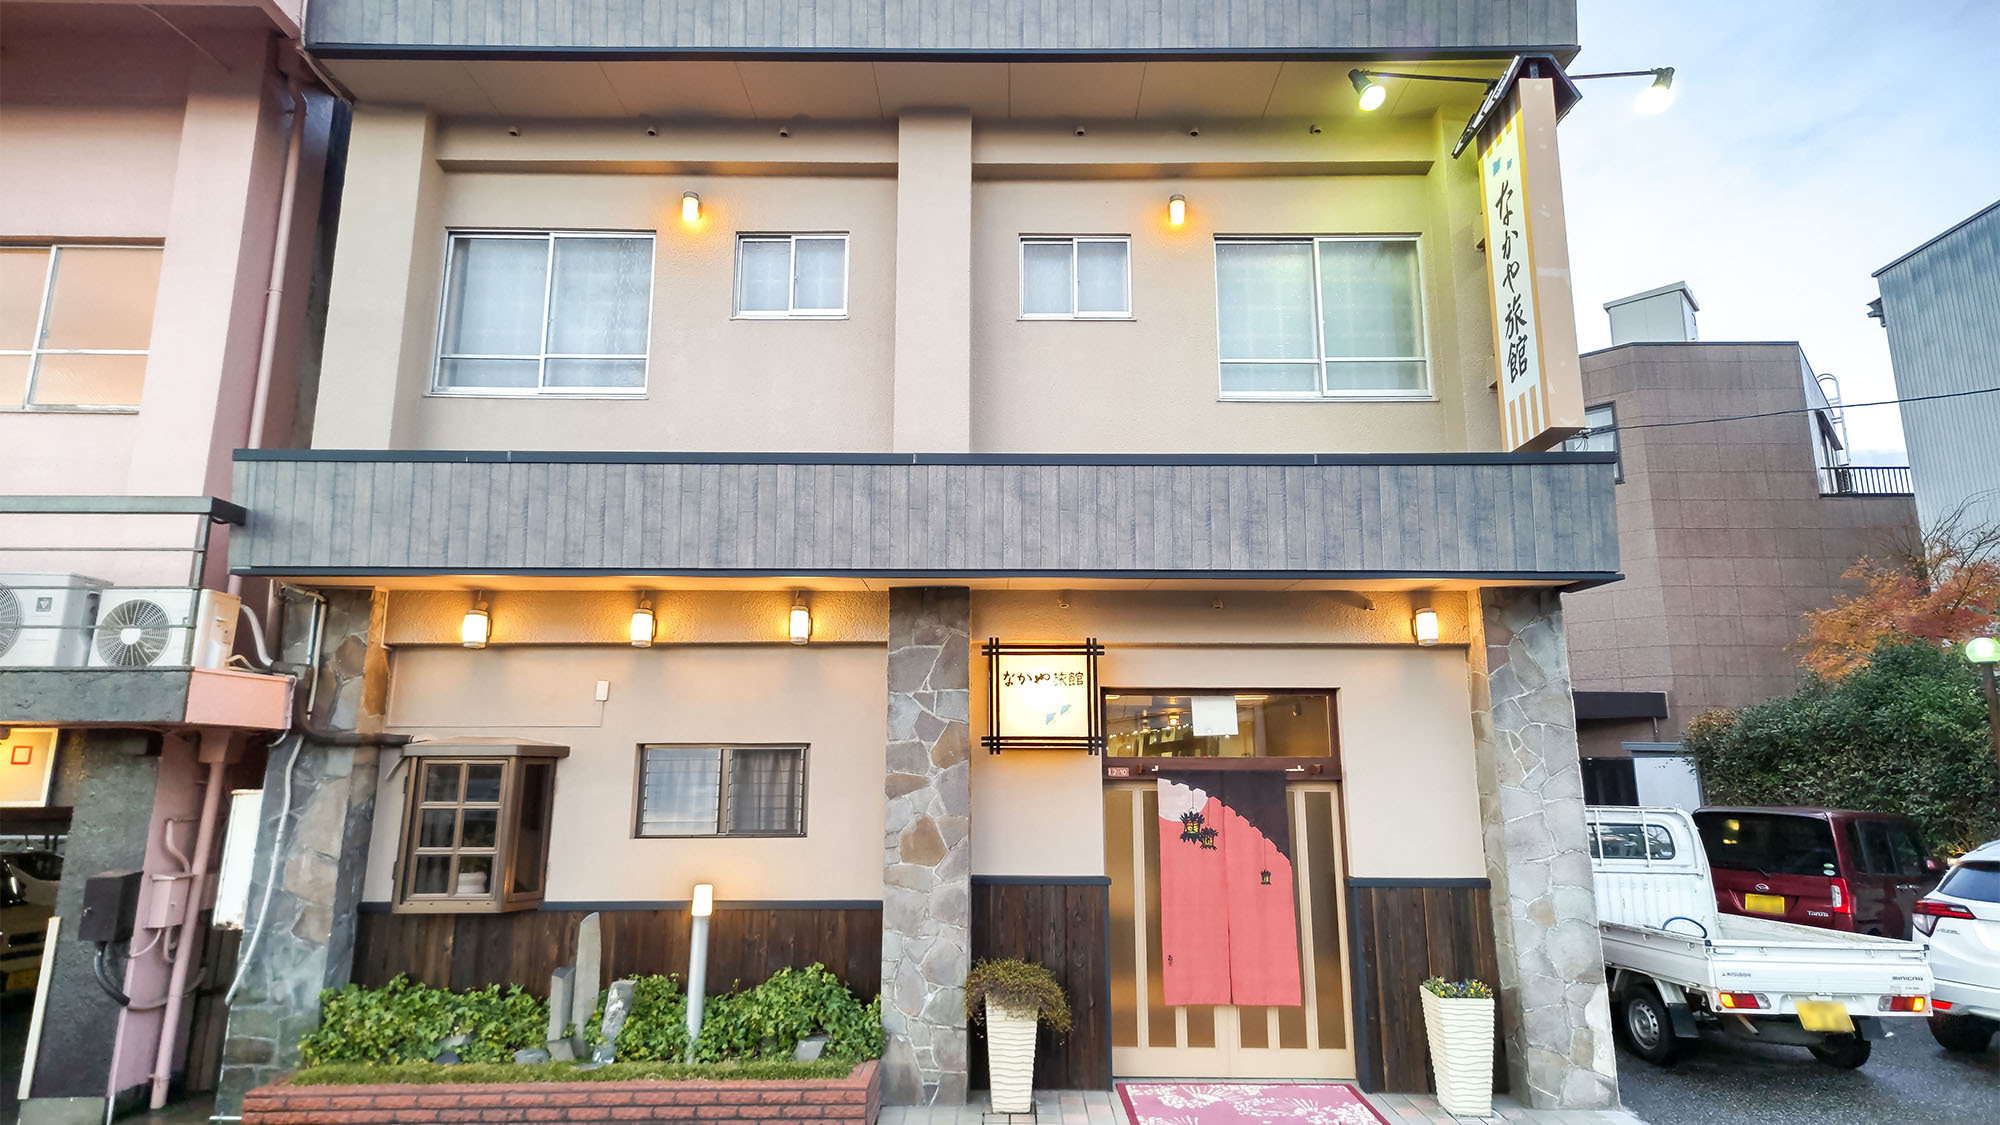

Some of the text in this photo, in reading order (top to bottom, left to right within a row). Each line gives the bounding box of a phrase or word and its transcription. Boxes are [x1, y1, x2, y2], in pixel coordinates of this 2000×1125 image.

[1495, 179, 1528, 384] なかや旅館
[1002, 670, 1084, 687] なかや旅館
